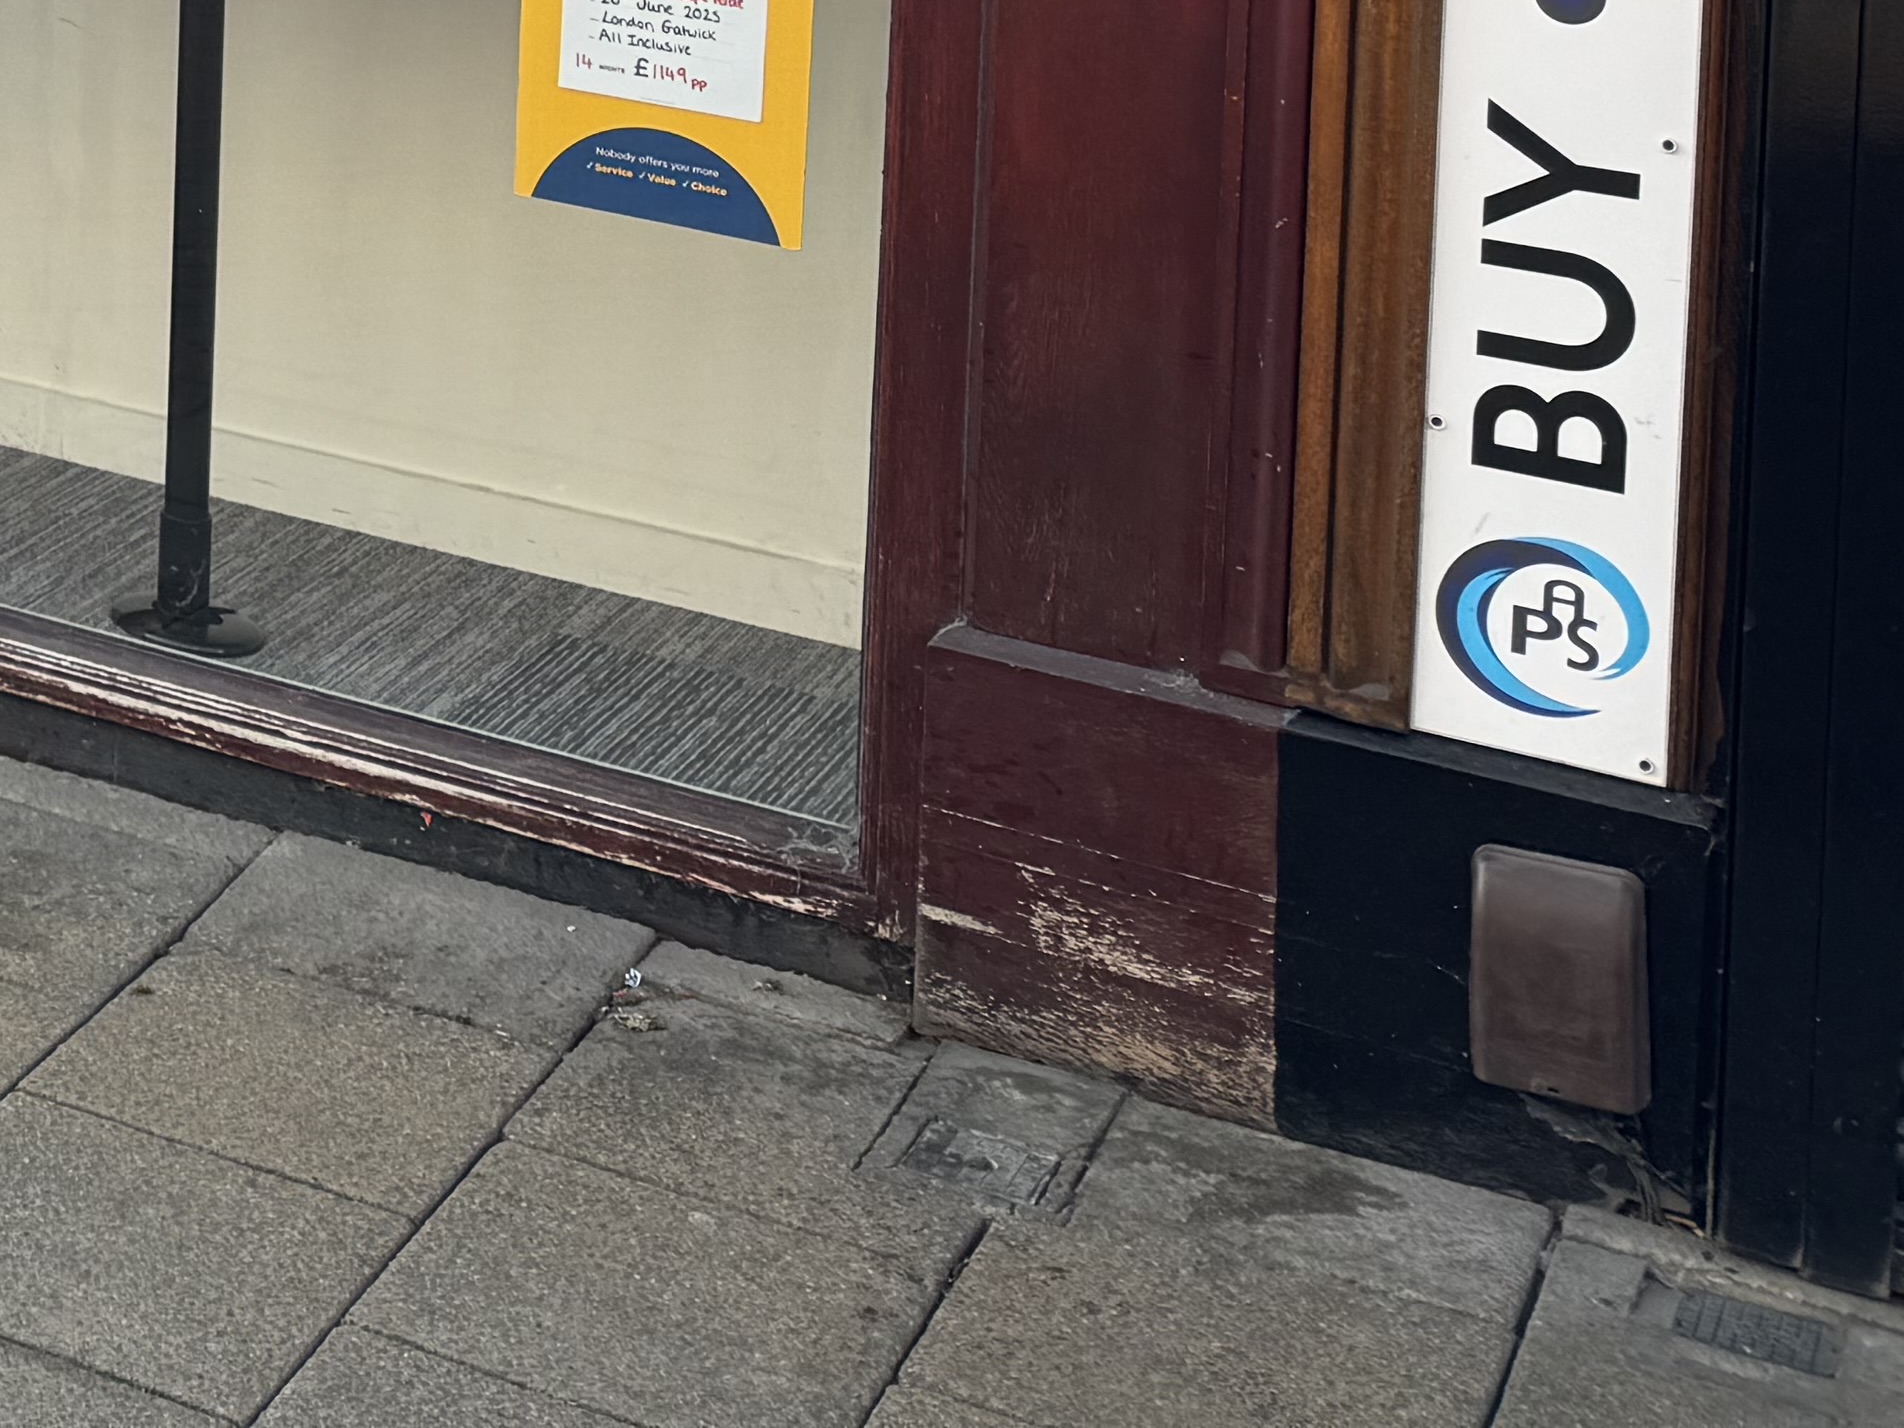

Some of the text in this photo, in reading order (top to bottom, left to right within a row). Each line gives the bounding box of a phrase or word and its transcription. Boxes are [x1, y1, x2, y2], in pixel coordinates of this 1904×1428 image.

[634, 58, 687, 84] £1149
[596, 146, 719, 178] Nobody offers you more
[1471, 96, 1639, 500] BUY
